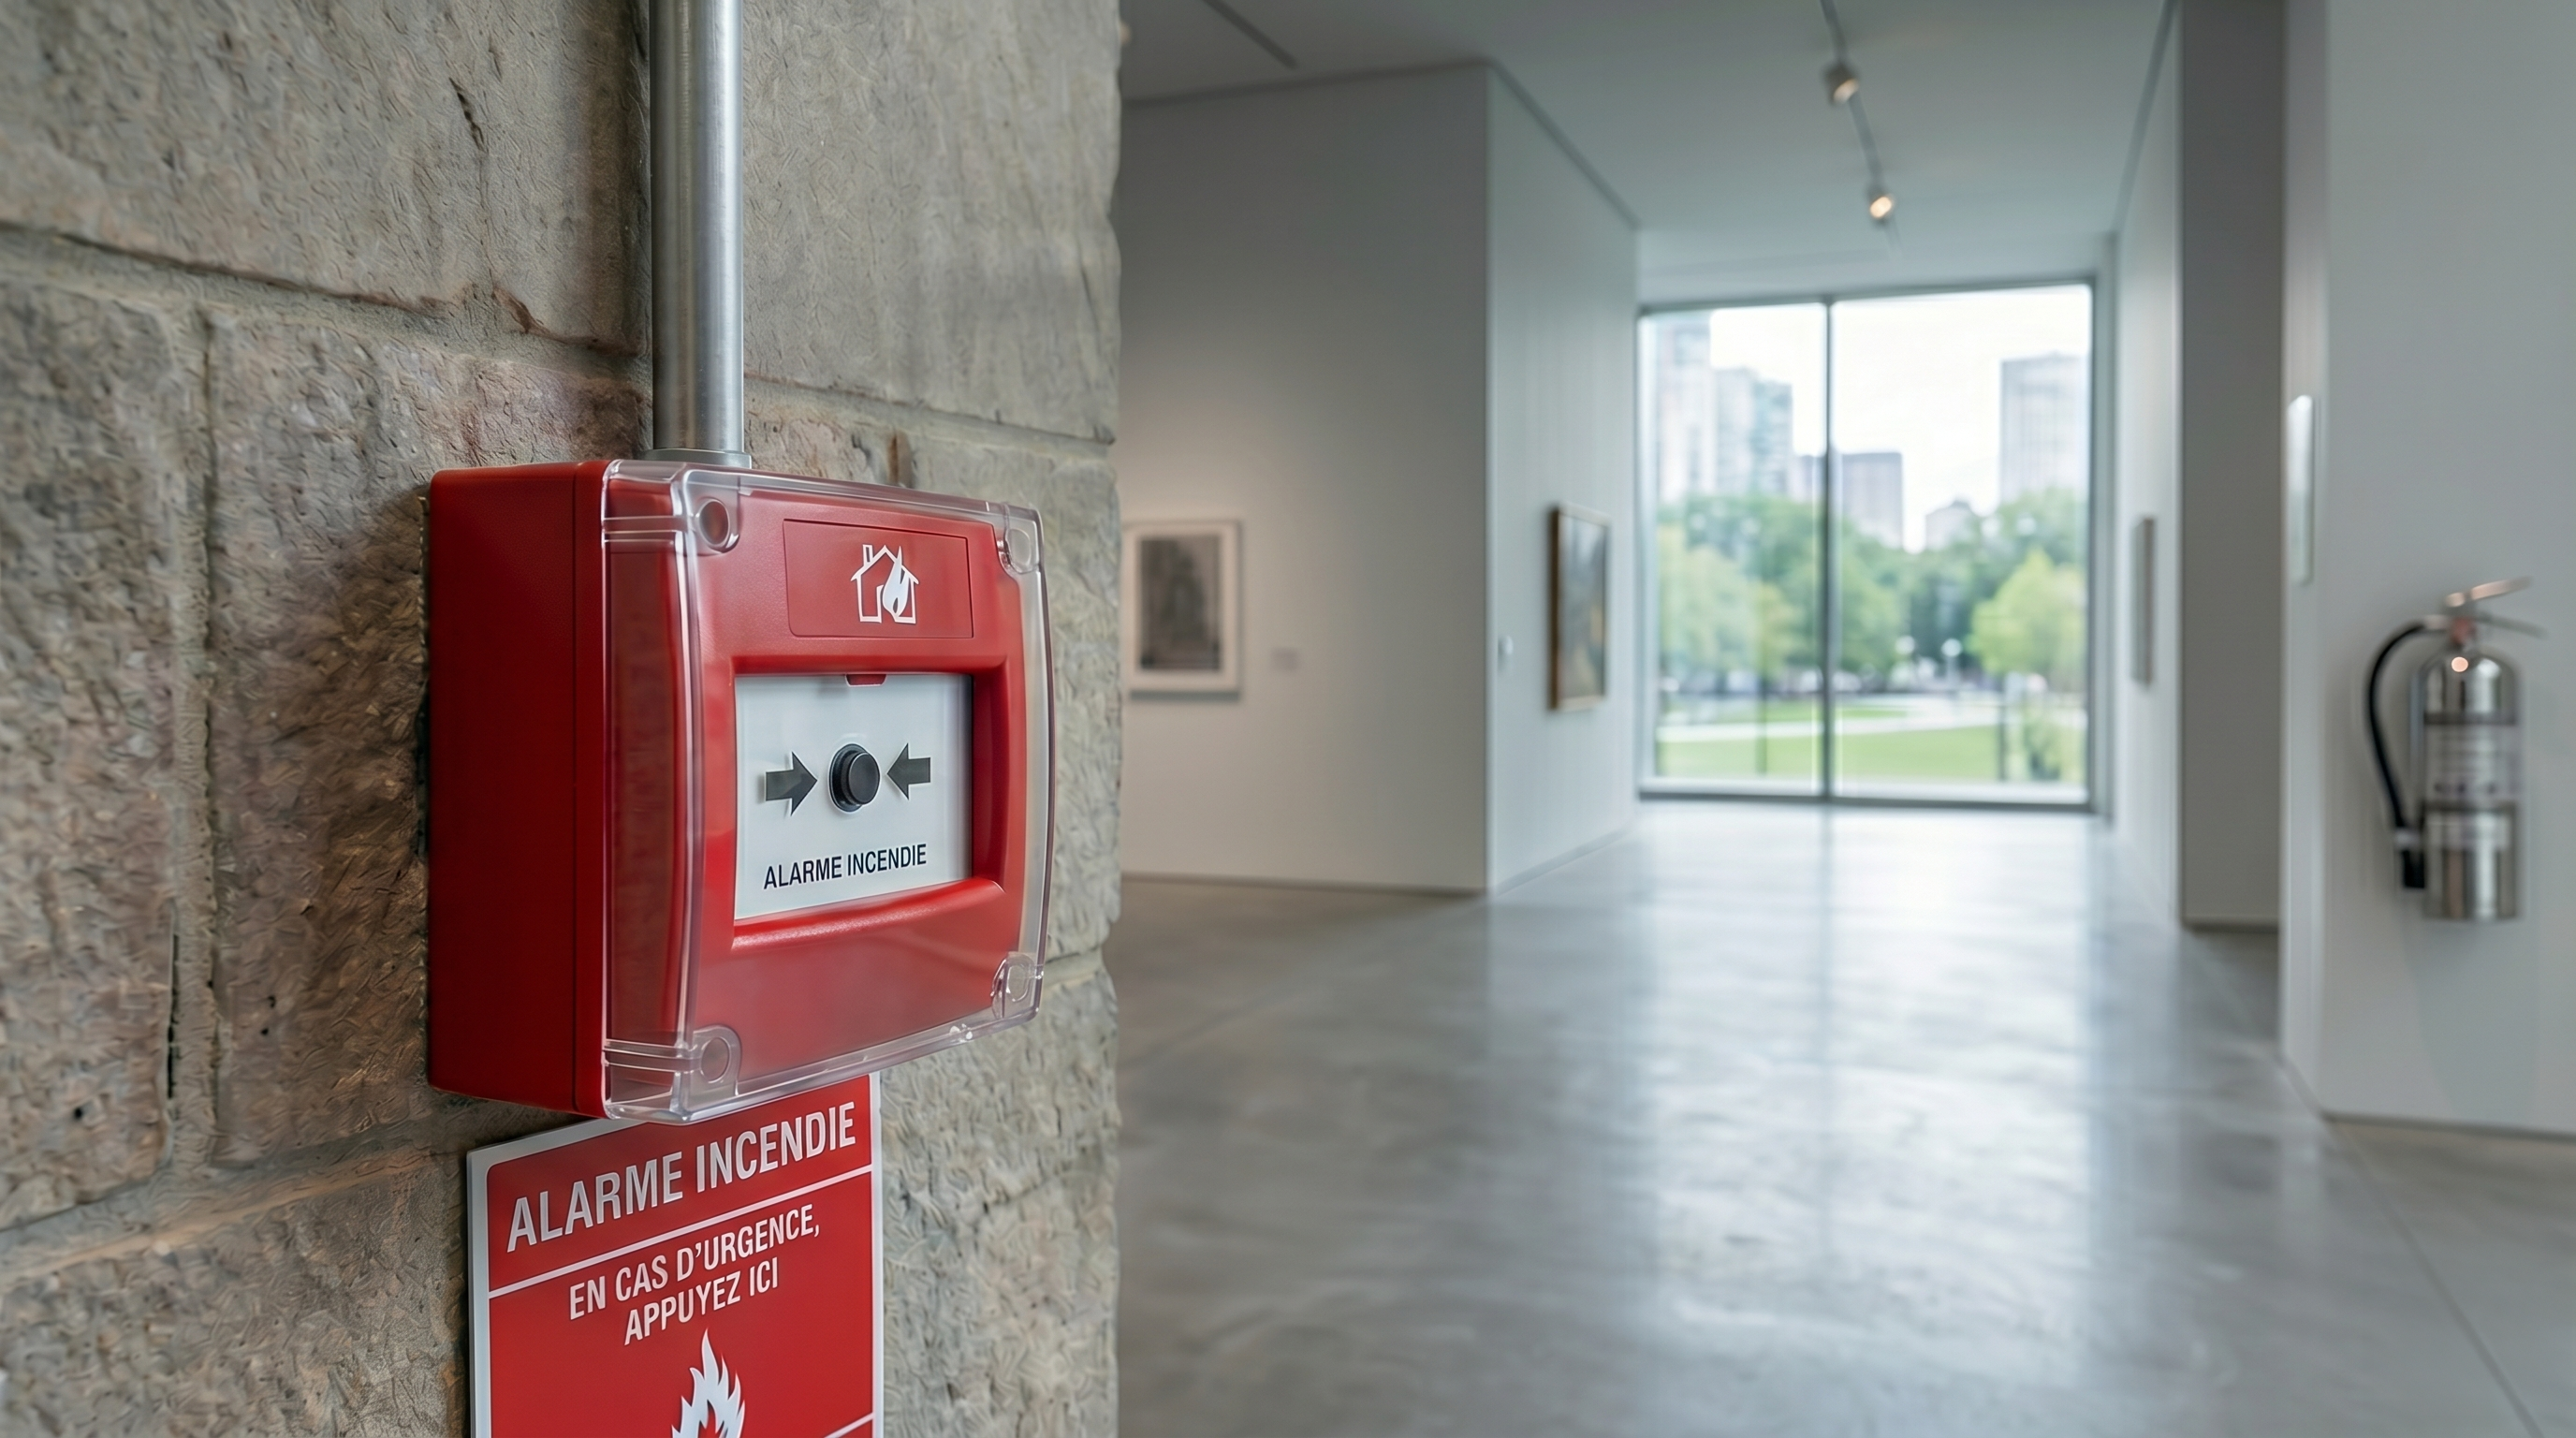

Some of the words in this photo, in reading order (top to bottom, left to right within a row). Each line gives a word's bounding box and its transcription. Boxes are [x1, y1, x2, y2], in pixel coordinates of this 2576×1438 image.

[764, 856, 842, 889] ALARME
[847, 844, 927, 876] INCENDIE
[506, 1152, 683, 1253] ALARME
[695, 1101, 856, 1194] INCENDIE
[569, 1279, 606, 1320] EN
[615, 1255, 668, 1301] CAS
[677, 1204, 820, 1282] D’URGENCE,
[624, 1271, 741, 1345] APPUYEZ
[749, 1256, 779, 1297] ICI
